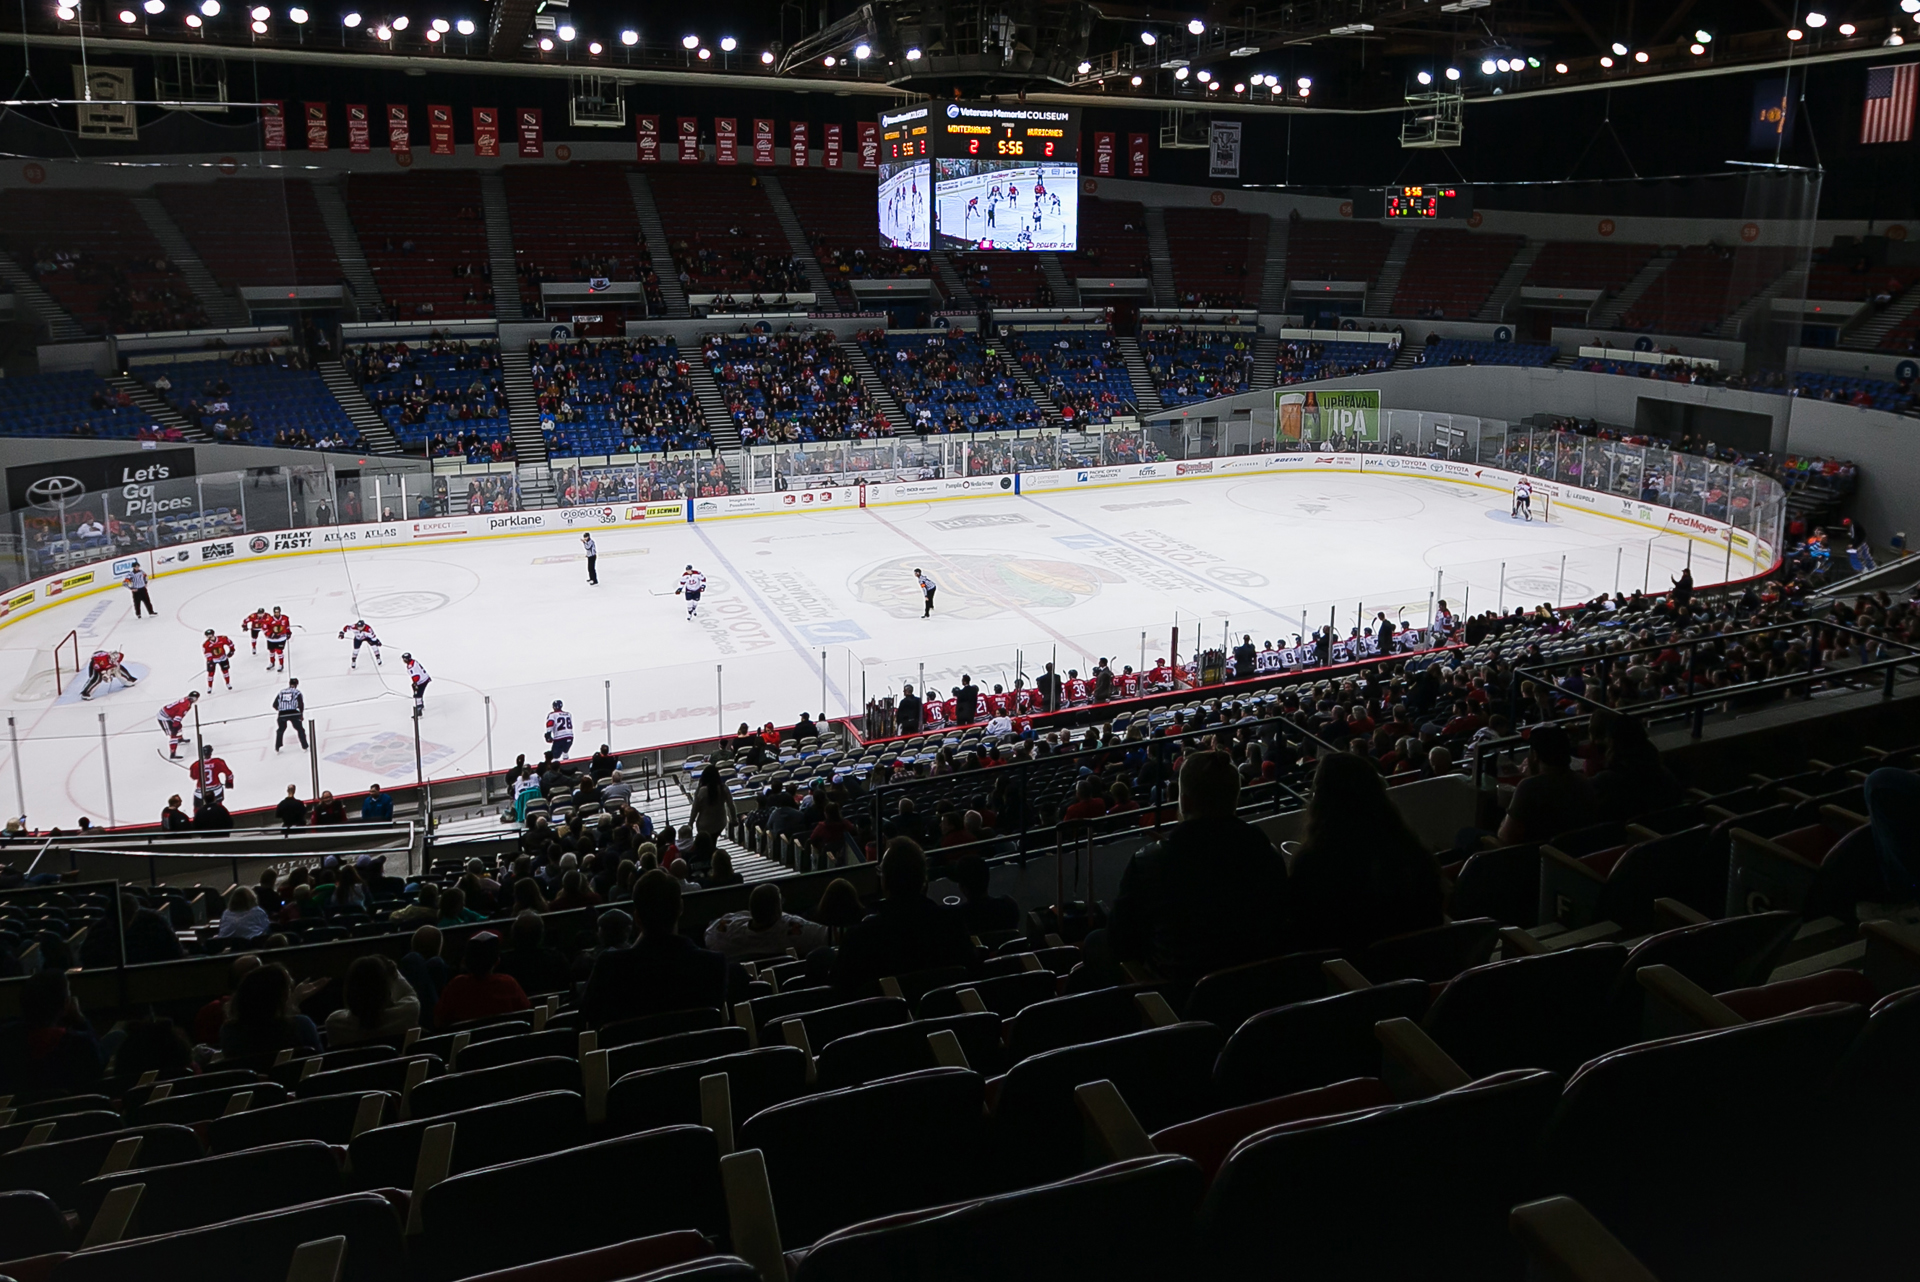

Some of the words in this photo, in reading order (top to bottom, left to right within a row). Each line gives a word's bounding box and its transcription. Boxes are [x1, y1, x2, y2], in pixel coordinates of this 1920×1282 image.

[960, 107, 993, 119] Veterans
[994, 109, 1026, 120] Memorial
[1027, 110, 1069, 122] COLISEUM
[947, 125, 992, 135] WINTERHAWKS
[1005, 128, 1012, 138] 1
[1026, 128, 1064, 137] HURRICANES
[969, 139, 980, 154] 2
[998, 140, 1024, 155] 5:56
[1044, 142, 1055, 157] 2
[555, 330, 566, 339] 26
[1500, 330, 1506, 340] 6
[1640, 342, 1646, 351] 7
[1904, 367, 1912, 377] 8
[1323, 395, 1373, 410] UPHEAVAL
[1332, 409, 1367, 436] IPA
[122, 464, 170, 484] Let's
[1138, 468, 1156, 476] tcms
[1444, 464, 1469, 473] TOYOTA
[122, 483, 154, 500] Go
[1572, 493, 1595, 504] LEUPOLD
[126, 496, 192, 517] Places
[656, 506, 680, 515] SCHWAB
[25, 511, 95, 529] TOYOTA
[1639, 510, 1651, 521] IPA
[423, 522, 452, 531] EXPECT
[490, 515, 543, 531] parklane
[1668, 512, 1689, 526] Fred
[1690, 518, 1718, 534] Meyer
[274, 532, 312, 541] FREAKY
[324, 532, 357, 542] ATLAS
[364, 528, 397, 540] ATLAS
[274, 538, 312, 551] FAST!
[1120, 531, 1207, 568] TOYOTA
[202, 550, 234, 560] CAMP
[772, 572, 834, 619] AUTOMATION
[711, 596, 776, 651] TOYOTA
[1267, 656, 1278, 667] 17
[1286, 652, 1294, 664] 9
[1072, 684, 1086, 698] 39
[1125, 684, 1135, 694] 19
[930, 706, 942, 720] 16
[976, 700, 988, 714] 21
[582, 712, 657, 734] Fred
[658, 700, 756, 722] Meyer
[556, 716, 572, 732] 28
